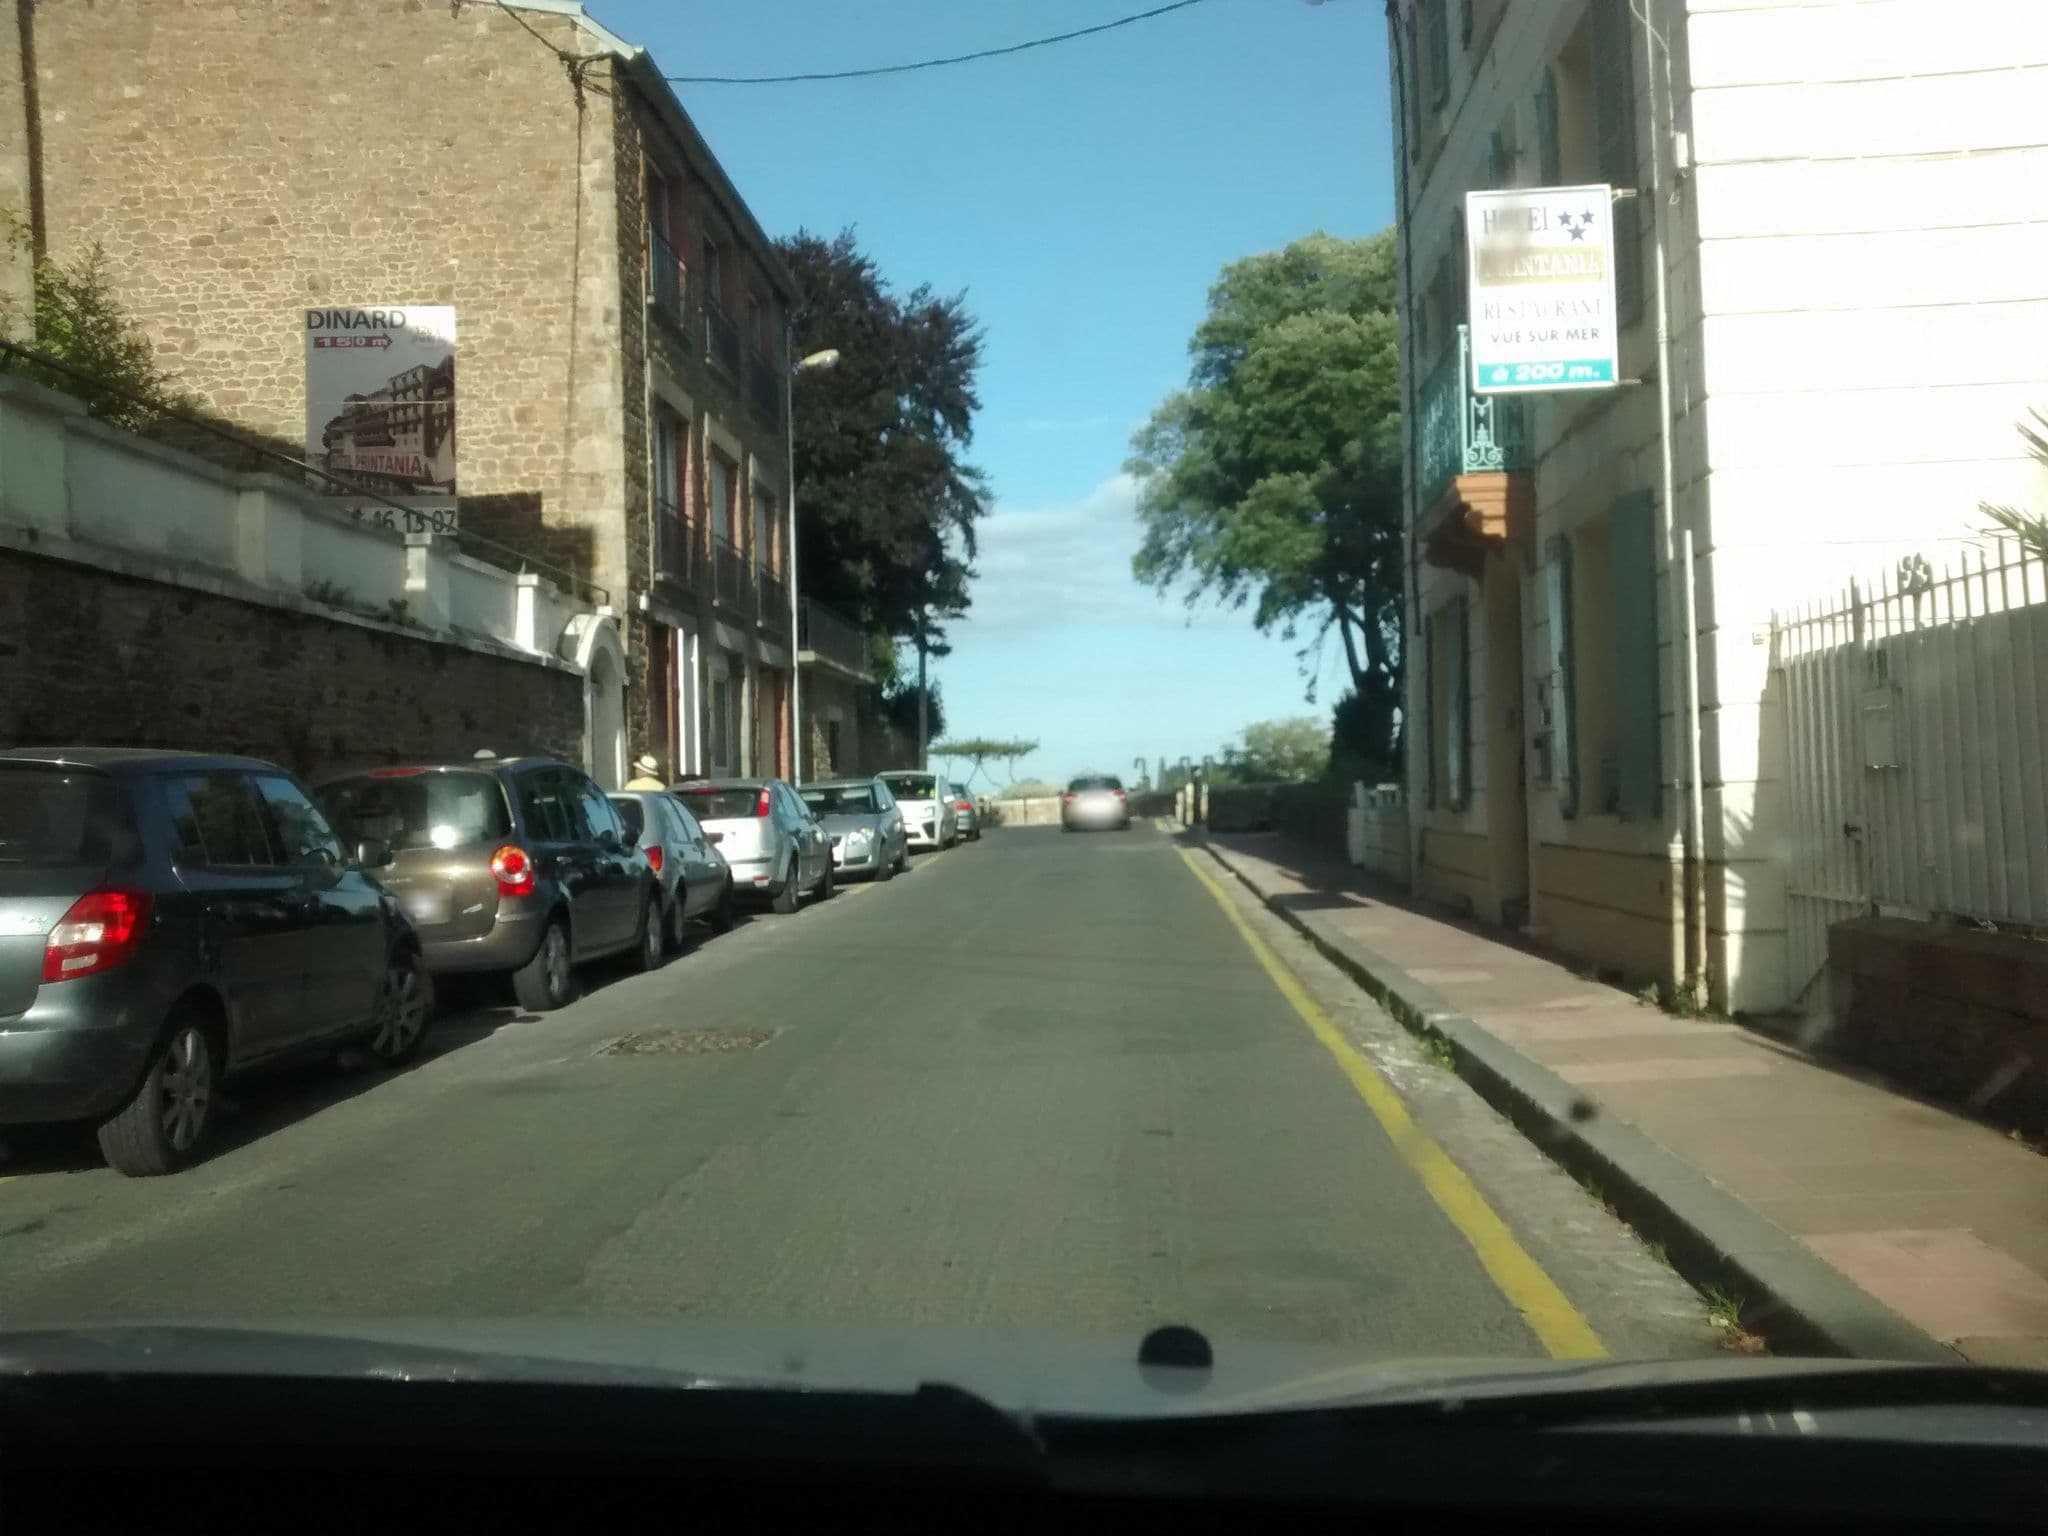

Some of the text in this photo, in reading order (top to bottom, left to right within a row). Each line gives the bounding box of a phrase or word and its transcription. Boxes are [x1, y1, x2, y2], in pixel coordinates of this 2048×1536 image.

[1483, 206, 1549, 235] HEL
[307, 310, 407, 329] DINARD
[318, 336, 366, 347] 150
[1491, 327, 1600, 344] VUE SUR MER
[1515, 363, 1566, 380] 200
[1568, 365, 1600, 379] m.
[432, 510, 457, 534] 07
